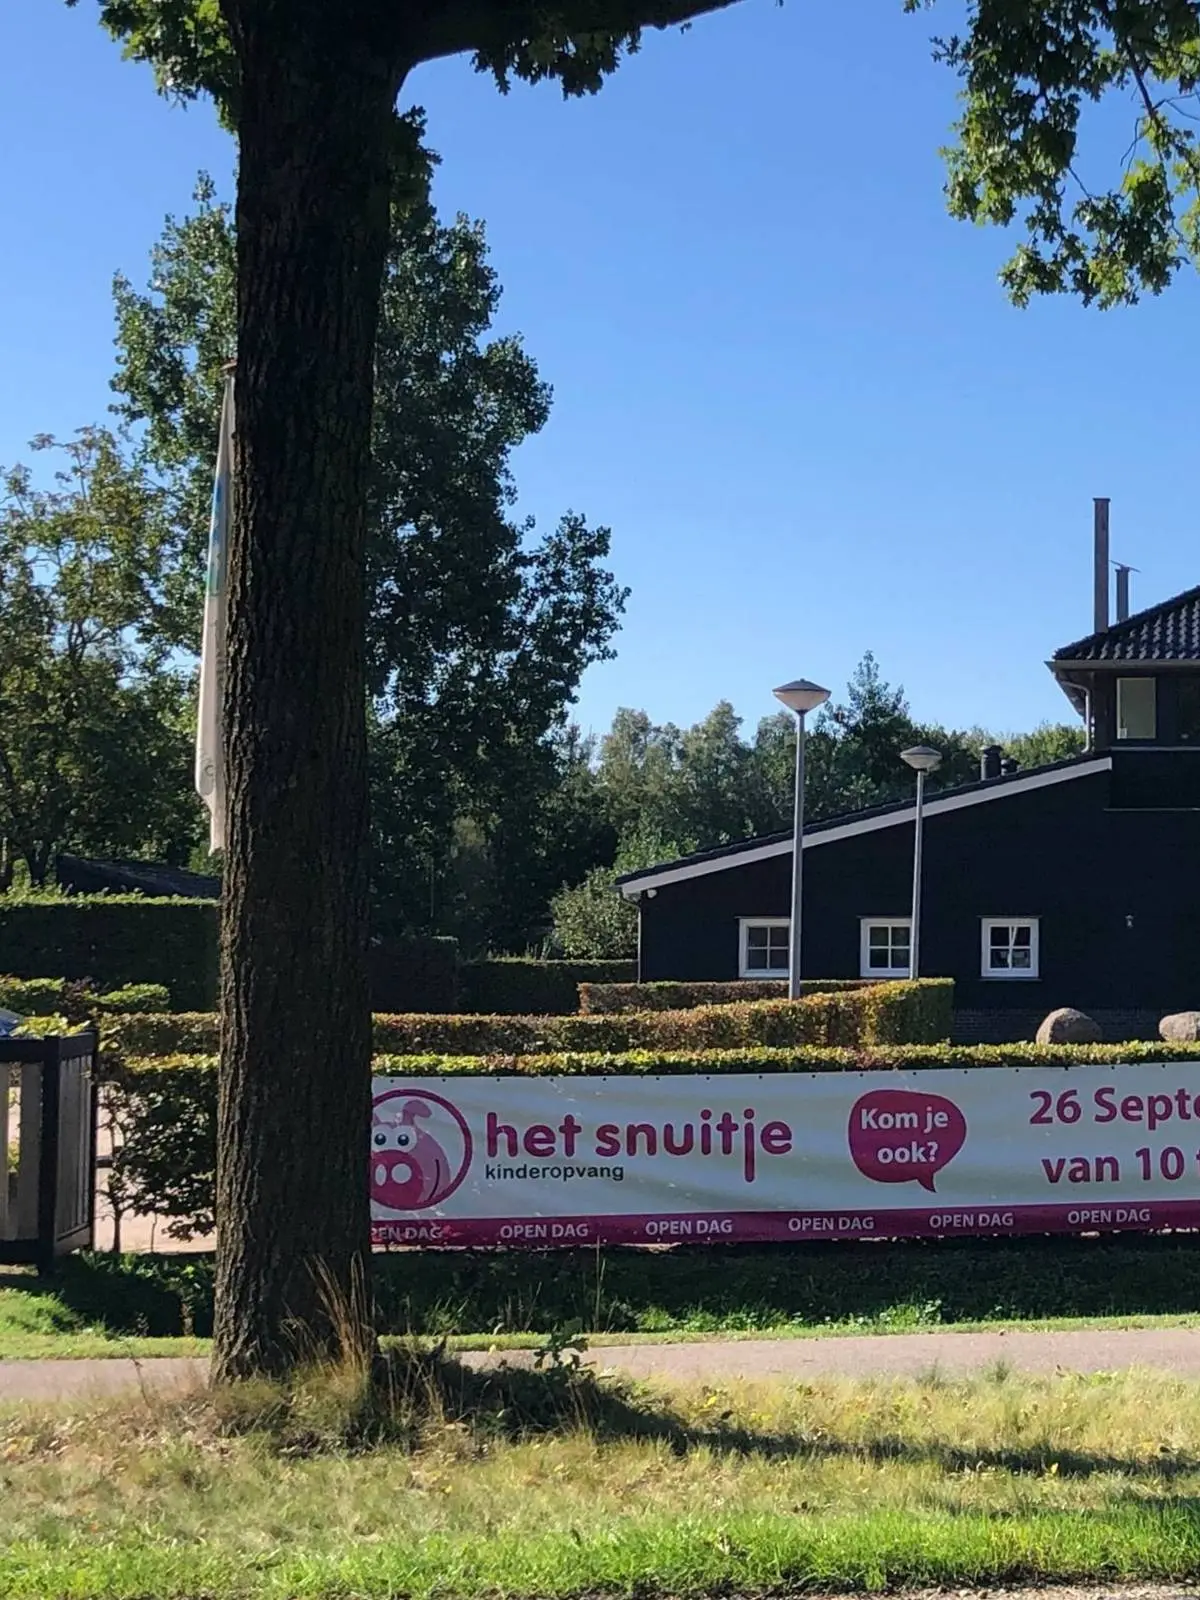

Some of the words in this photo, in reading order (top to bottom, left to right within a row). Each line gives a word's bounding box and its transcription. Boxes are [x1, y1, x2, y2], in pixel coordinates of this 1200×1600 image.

[1029, 1089, 1082, 1125] 26
[861, 1108, 918, 1130] Kom
[923, 1106, 949, 1134] je
[486, 1111, 582, 1158] het
[595, 1108, 793, 1183] snuitje
[877, 1141, 938, 1164] ook?
[485, 1161, 624, 1182] kinderopvang
[1041, 1154, 1120, 1184] van
[1135, 1146, 1185, 1181] 10
[788, 1217, 834, 1232] OPEN
[838, 1216, 875, 1230] DAG
[929, 1213, 974, 1228] OPEN
[978, 1212, 1014, 1227] DAG
[1067, 1209, 1112, 1224] OPEN
[1115, 1208, 1150, 1223] DAG
[370, 1226, 401, 1242] PEN
[404, 1225, 443, 1240] DAG
[500, 1224, 547, 1238] OPEN
[551, 1223, 588, 1237] DAG
[645, 1220, 692, 1235] OPEN
[696, 1219, 733, 1234] DAG
